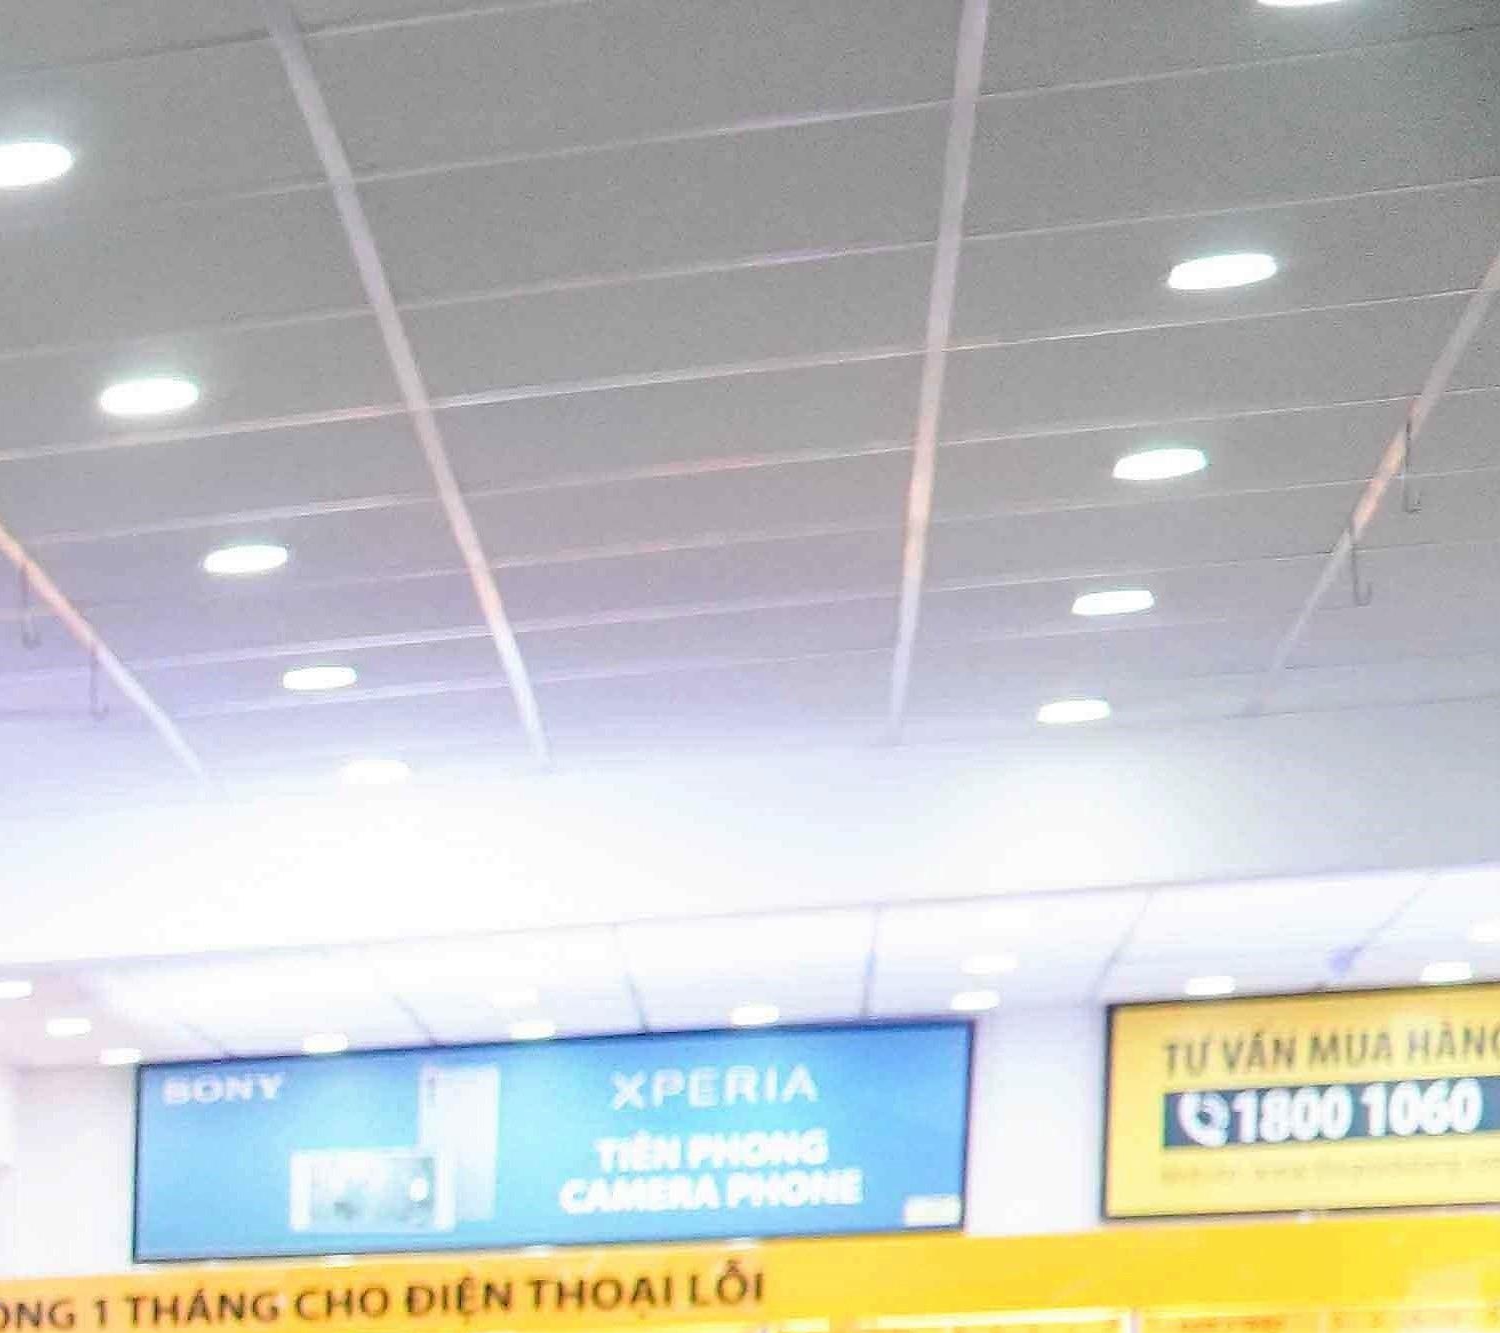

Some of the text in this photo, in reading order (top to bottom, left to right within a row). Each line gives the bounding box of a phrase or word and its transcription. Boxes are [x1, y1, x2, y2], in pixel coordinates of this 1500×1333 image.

[1308, 1030, 1393, 1069] MUA
[161, 1072, 286, 1106] SONY
[611, 1064, 818, 1110] XPERIA
[1232, 1077, 1483, 1144] 1800 1060
[689, 1127, 829, 1168] PHONG
[559, 1169, 863, 1215] CAMERA PHONE
[94, 1298, 108, 1330] 1
[128, 1275, 280, 1329] THÁNG
[293, 1284, 390, 1320] CHO
[404, 1275, 513, 1326] ĐIỆN
[530, 1274, 674, 1323] THOẠI
